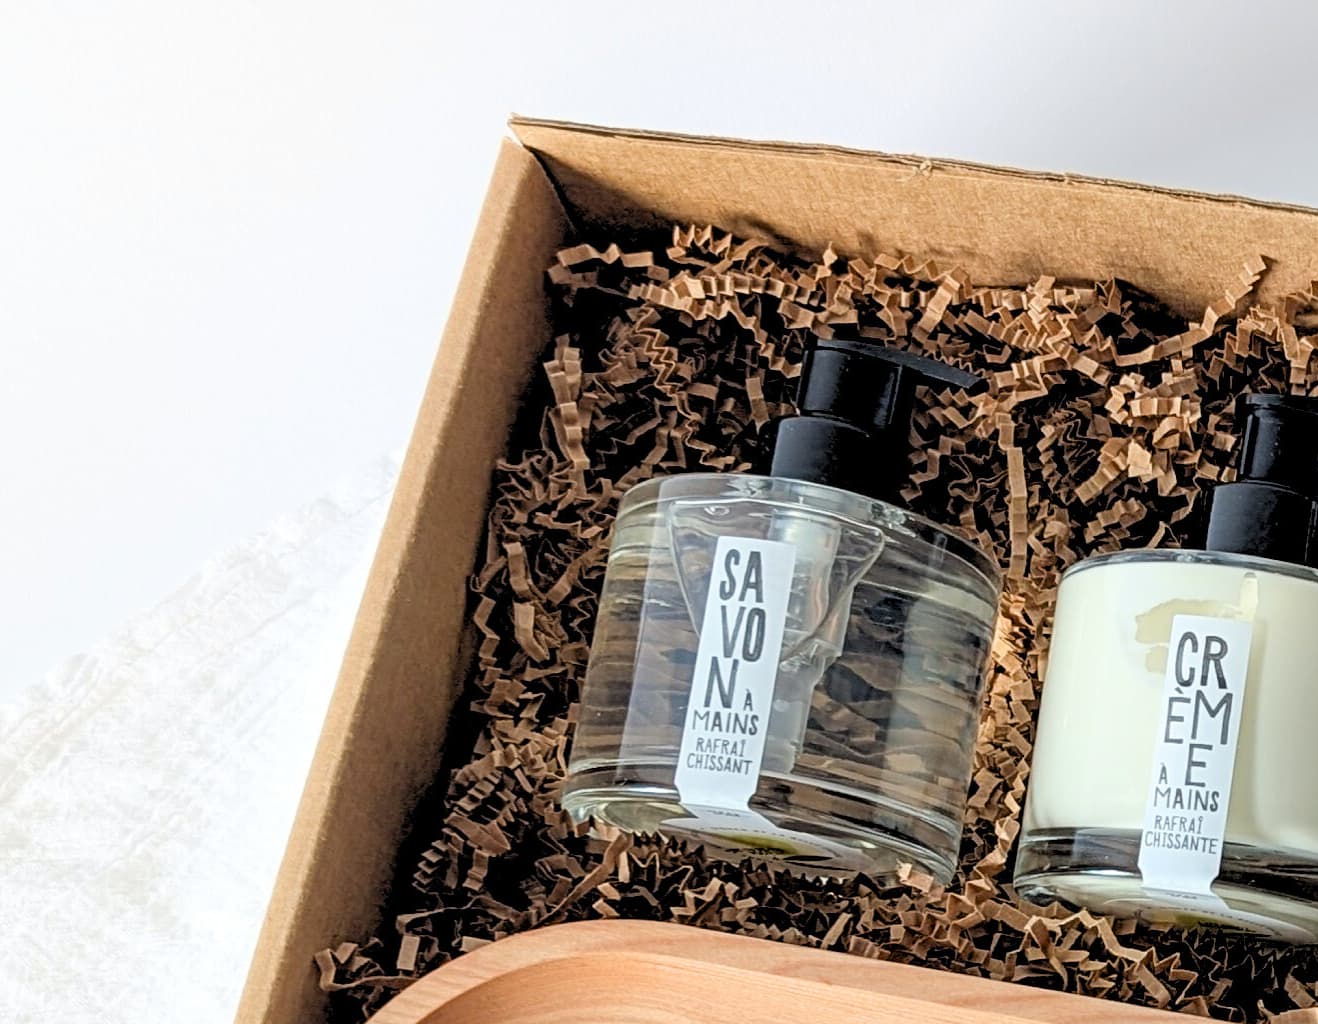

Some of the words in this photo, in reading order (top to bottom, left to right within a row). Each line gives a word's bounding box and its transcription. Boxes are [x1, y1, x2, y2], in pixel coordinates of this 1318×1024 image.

[719, 548, 764, 603] SA
[720, 604, 767, 663] VO
[704, 656, 739, 709] N
[1174, 631, 1229, 690] CR
[692, 709, 760, 736] MAINS
[686, 753, 753, 776] CHISSANT
[1184, 743, 1214, 788] E
[1153, 787, 1220, 813] MAINS
[1144, 832, 1219, 855] CHISSANTE
